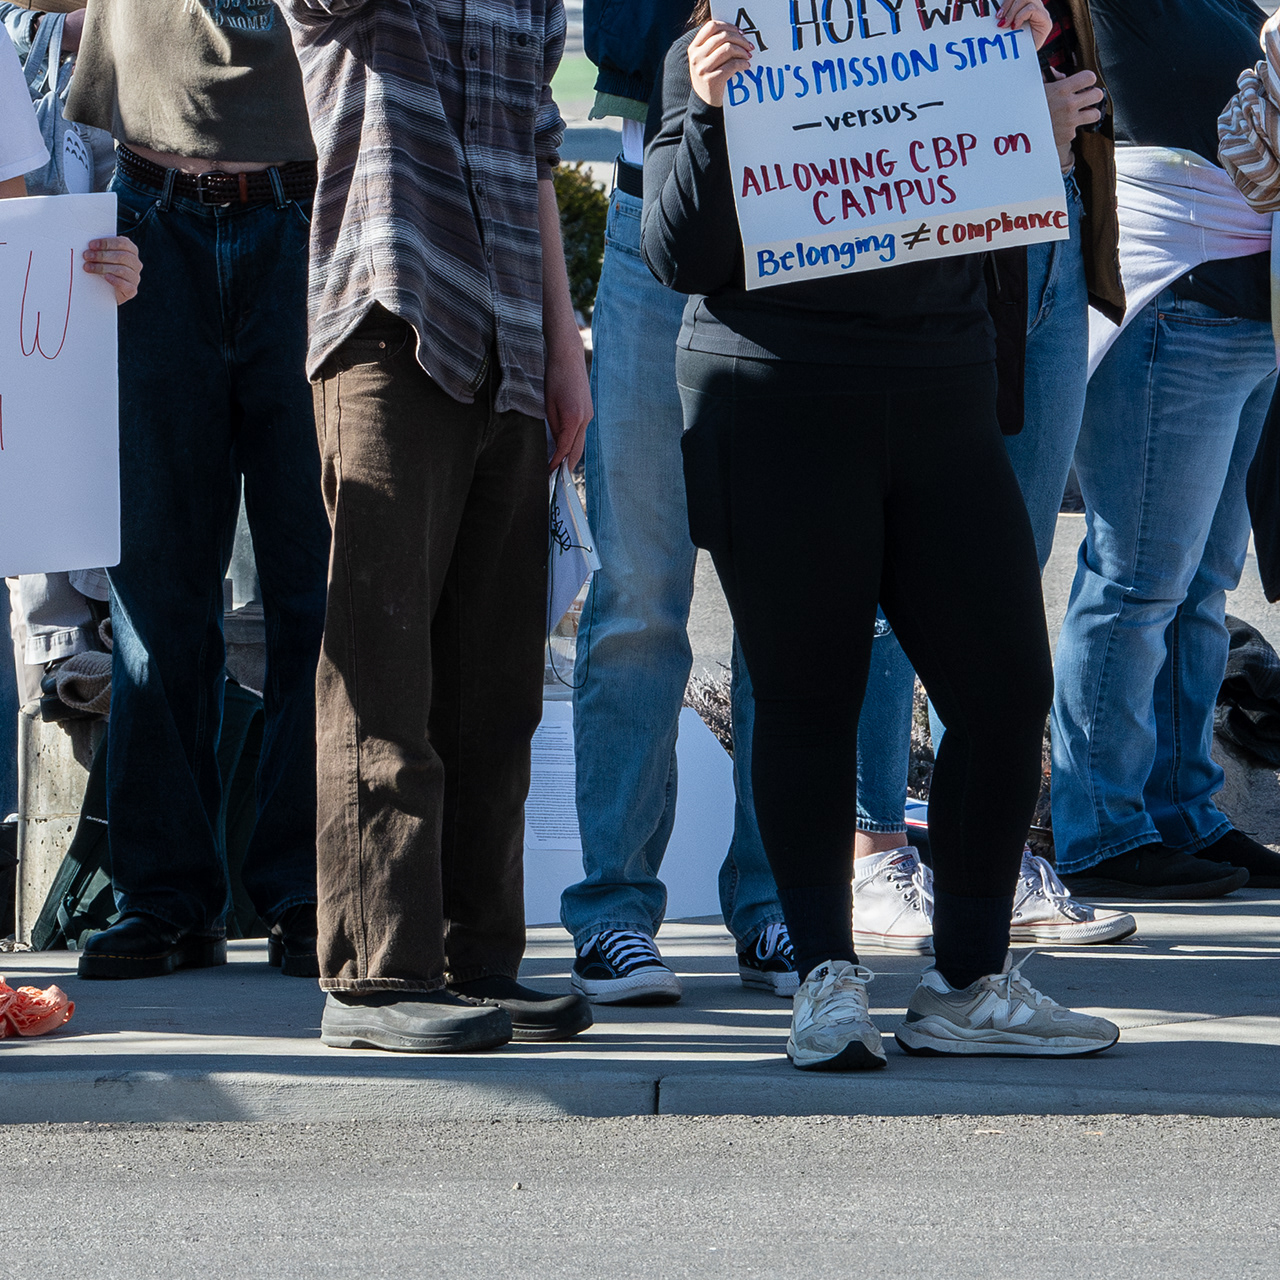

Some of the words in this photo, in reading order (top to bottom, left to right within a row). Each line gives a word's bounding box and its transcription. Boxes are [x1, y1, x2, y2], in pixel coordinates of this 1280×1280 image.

[733, 7, 769, 52] A
[726, 63, 809, 107] BYU'S
[811, 43, 939, 95] MISSION
[945, 28, 1025, 72] STMT
[741, 148, 898, 197] ALLOWING
[909, 133, 977, 173] CBP
[993, 132, 1032, 156] on
[812, 174, 957, 226] CAMPUS
[757, 233, 896, 278] Belonging
[936, 208, 1070, 244] compliance
